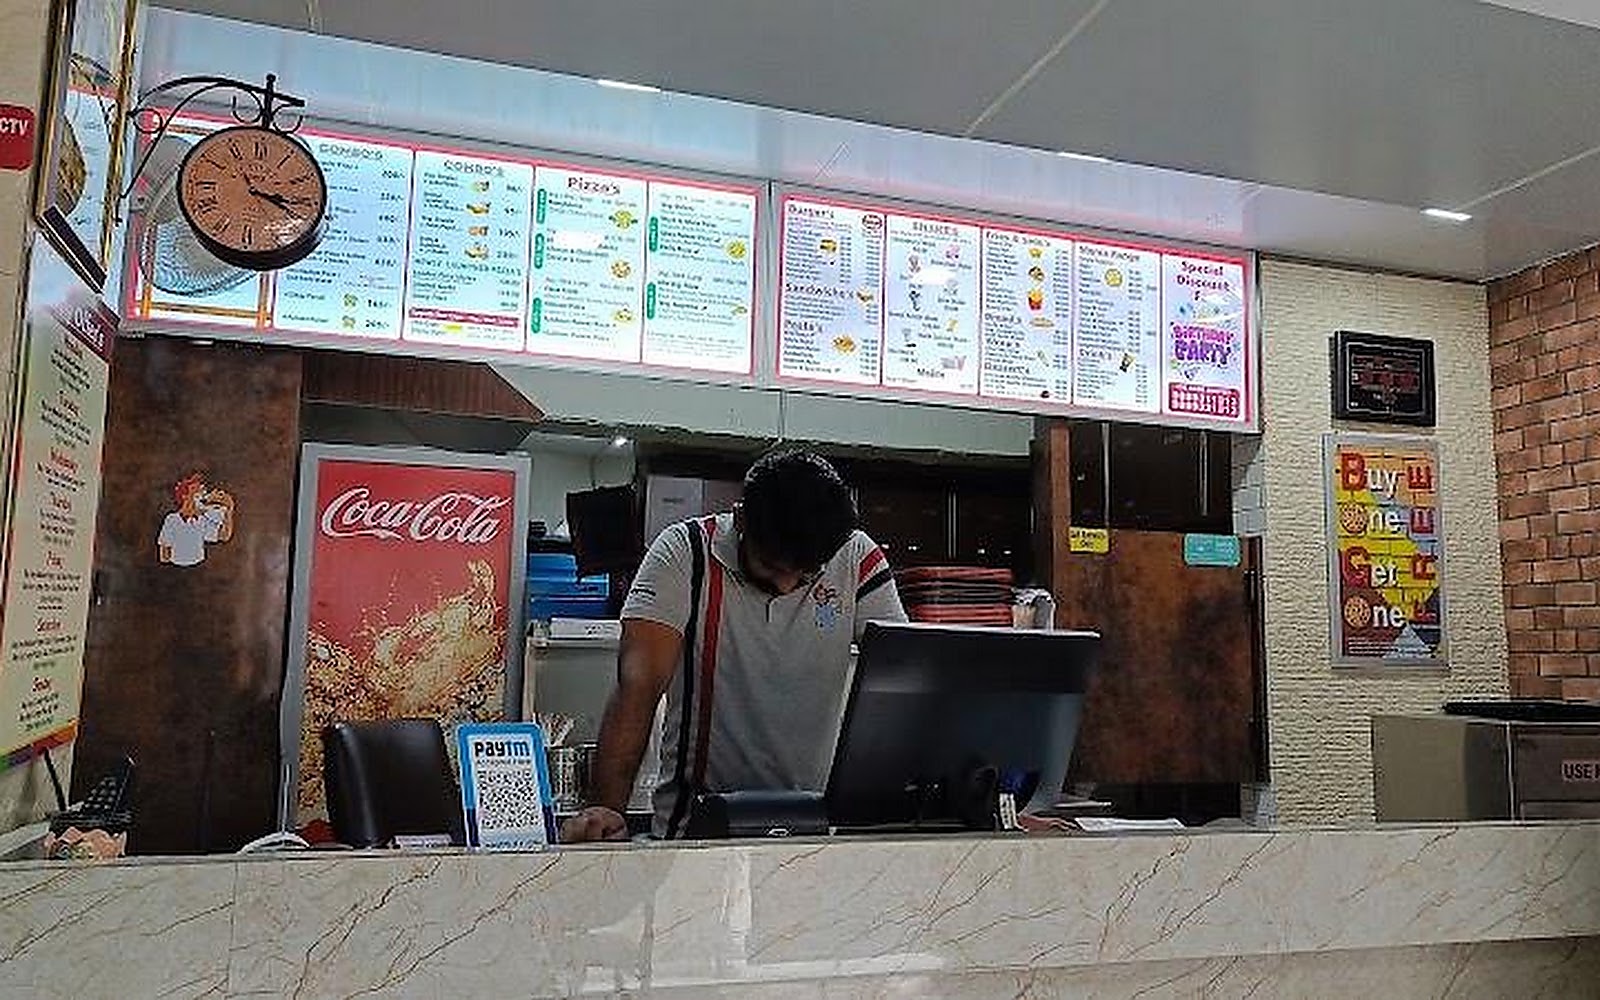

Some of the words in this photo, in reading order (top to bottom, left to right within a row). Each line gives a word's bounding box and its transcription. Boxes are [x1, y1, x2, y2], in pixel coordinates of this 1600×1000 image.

[1181, 260, 1223, 276] Special
[1175, 339, 1232, 367] PARTY
[1340, 452, 1399, 501] Buy
[1563, 762, 1593, 780] USE
